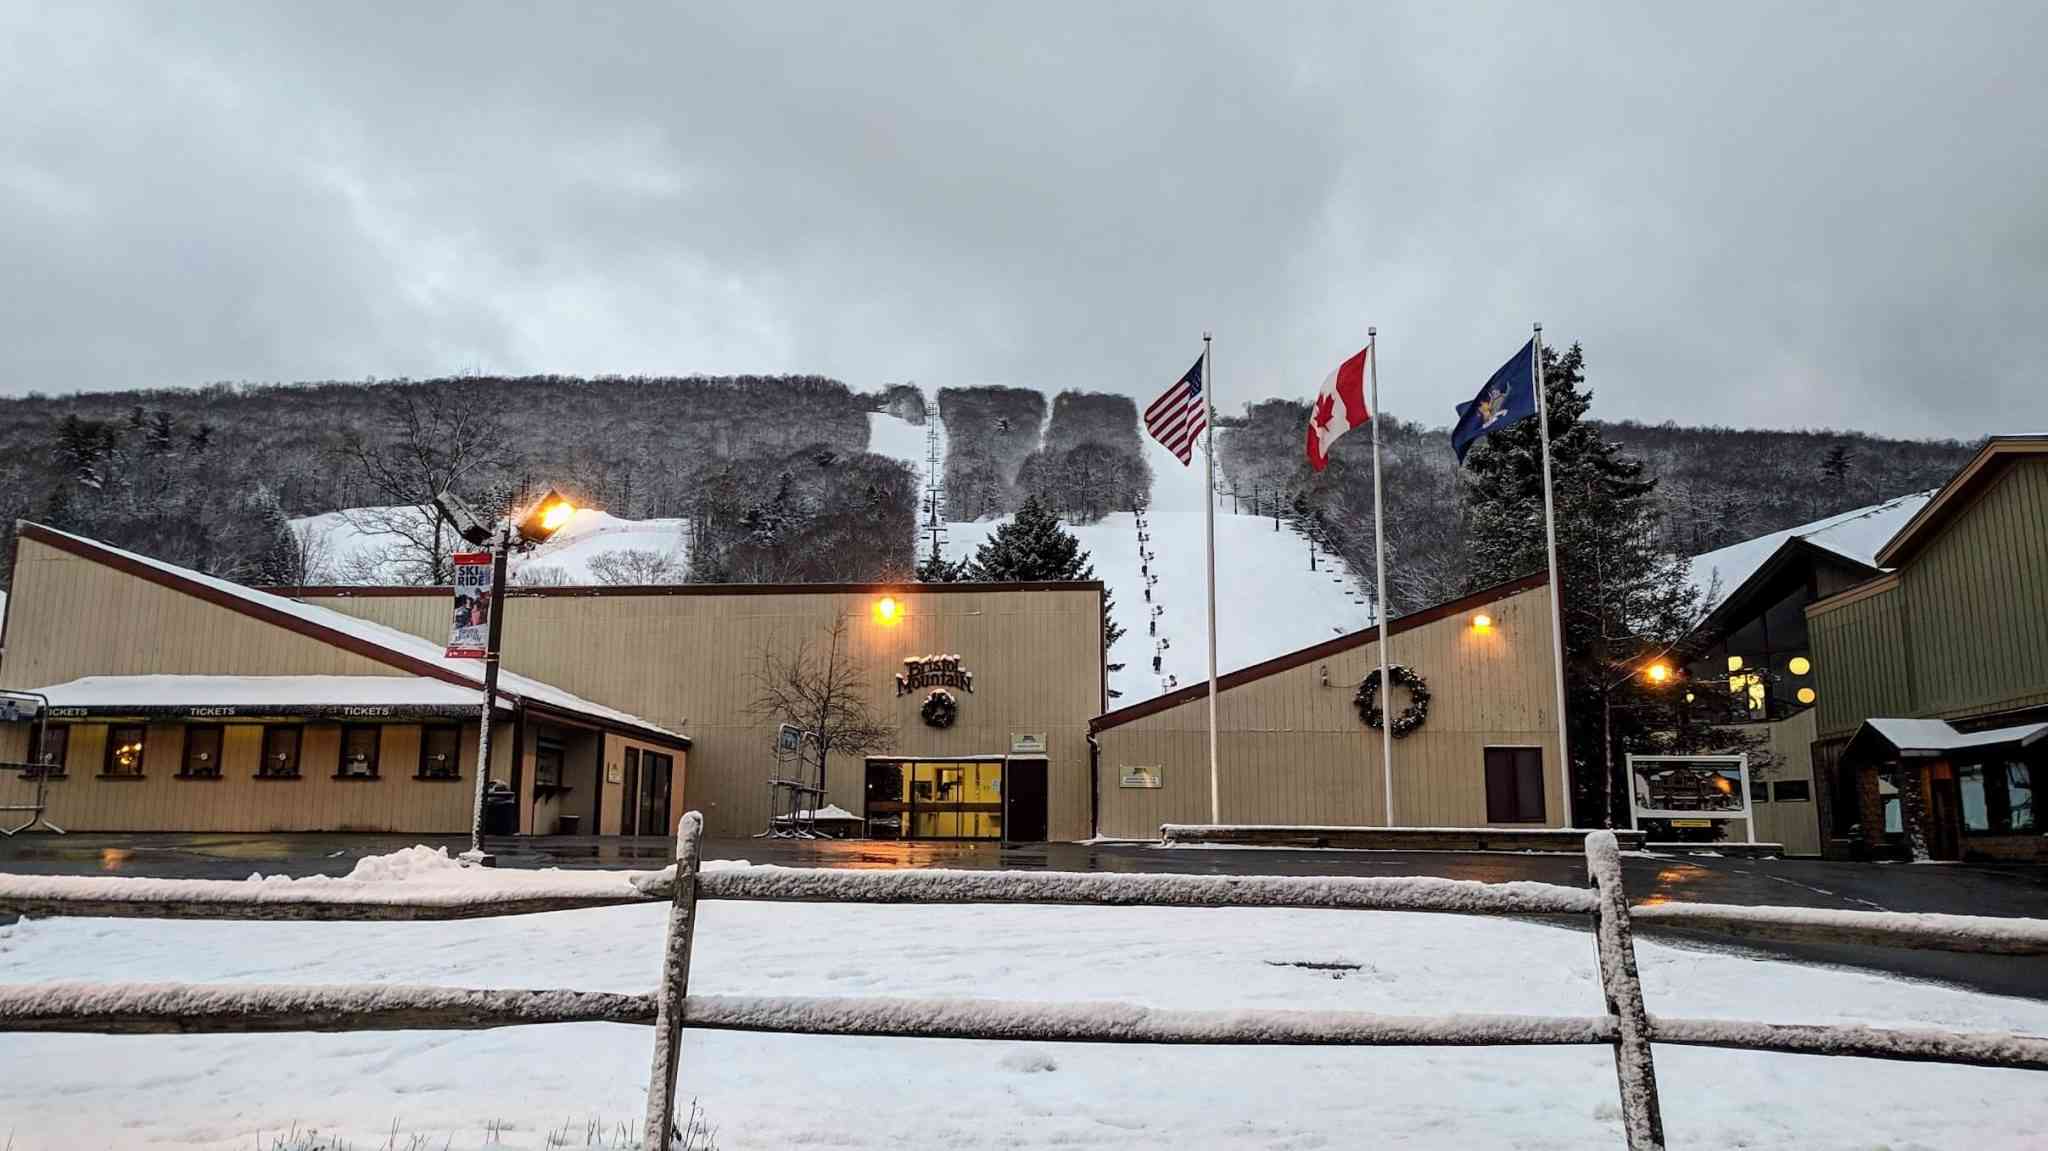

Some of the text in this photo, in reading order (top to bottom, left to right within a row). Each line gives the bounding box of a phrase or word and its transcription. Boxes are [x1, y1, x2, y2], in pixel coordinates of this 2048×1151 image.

[459, 566, 479, 576] SKI
[458, 576, 484, 586] RIDE
[46, 708, 88, 716] ICKETS
[191, 707, 235, 716] TICKETS
[344, 706, 389, 716] TICKETS
